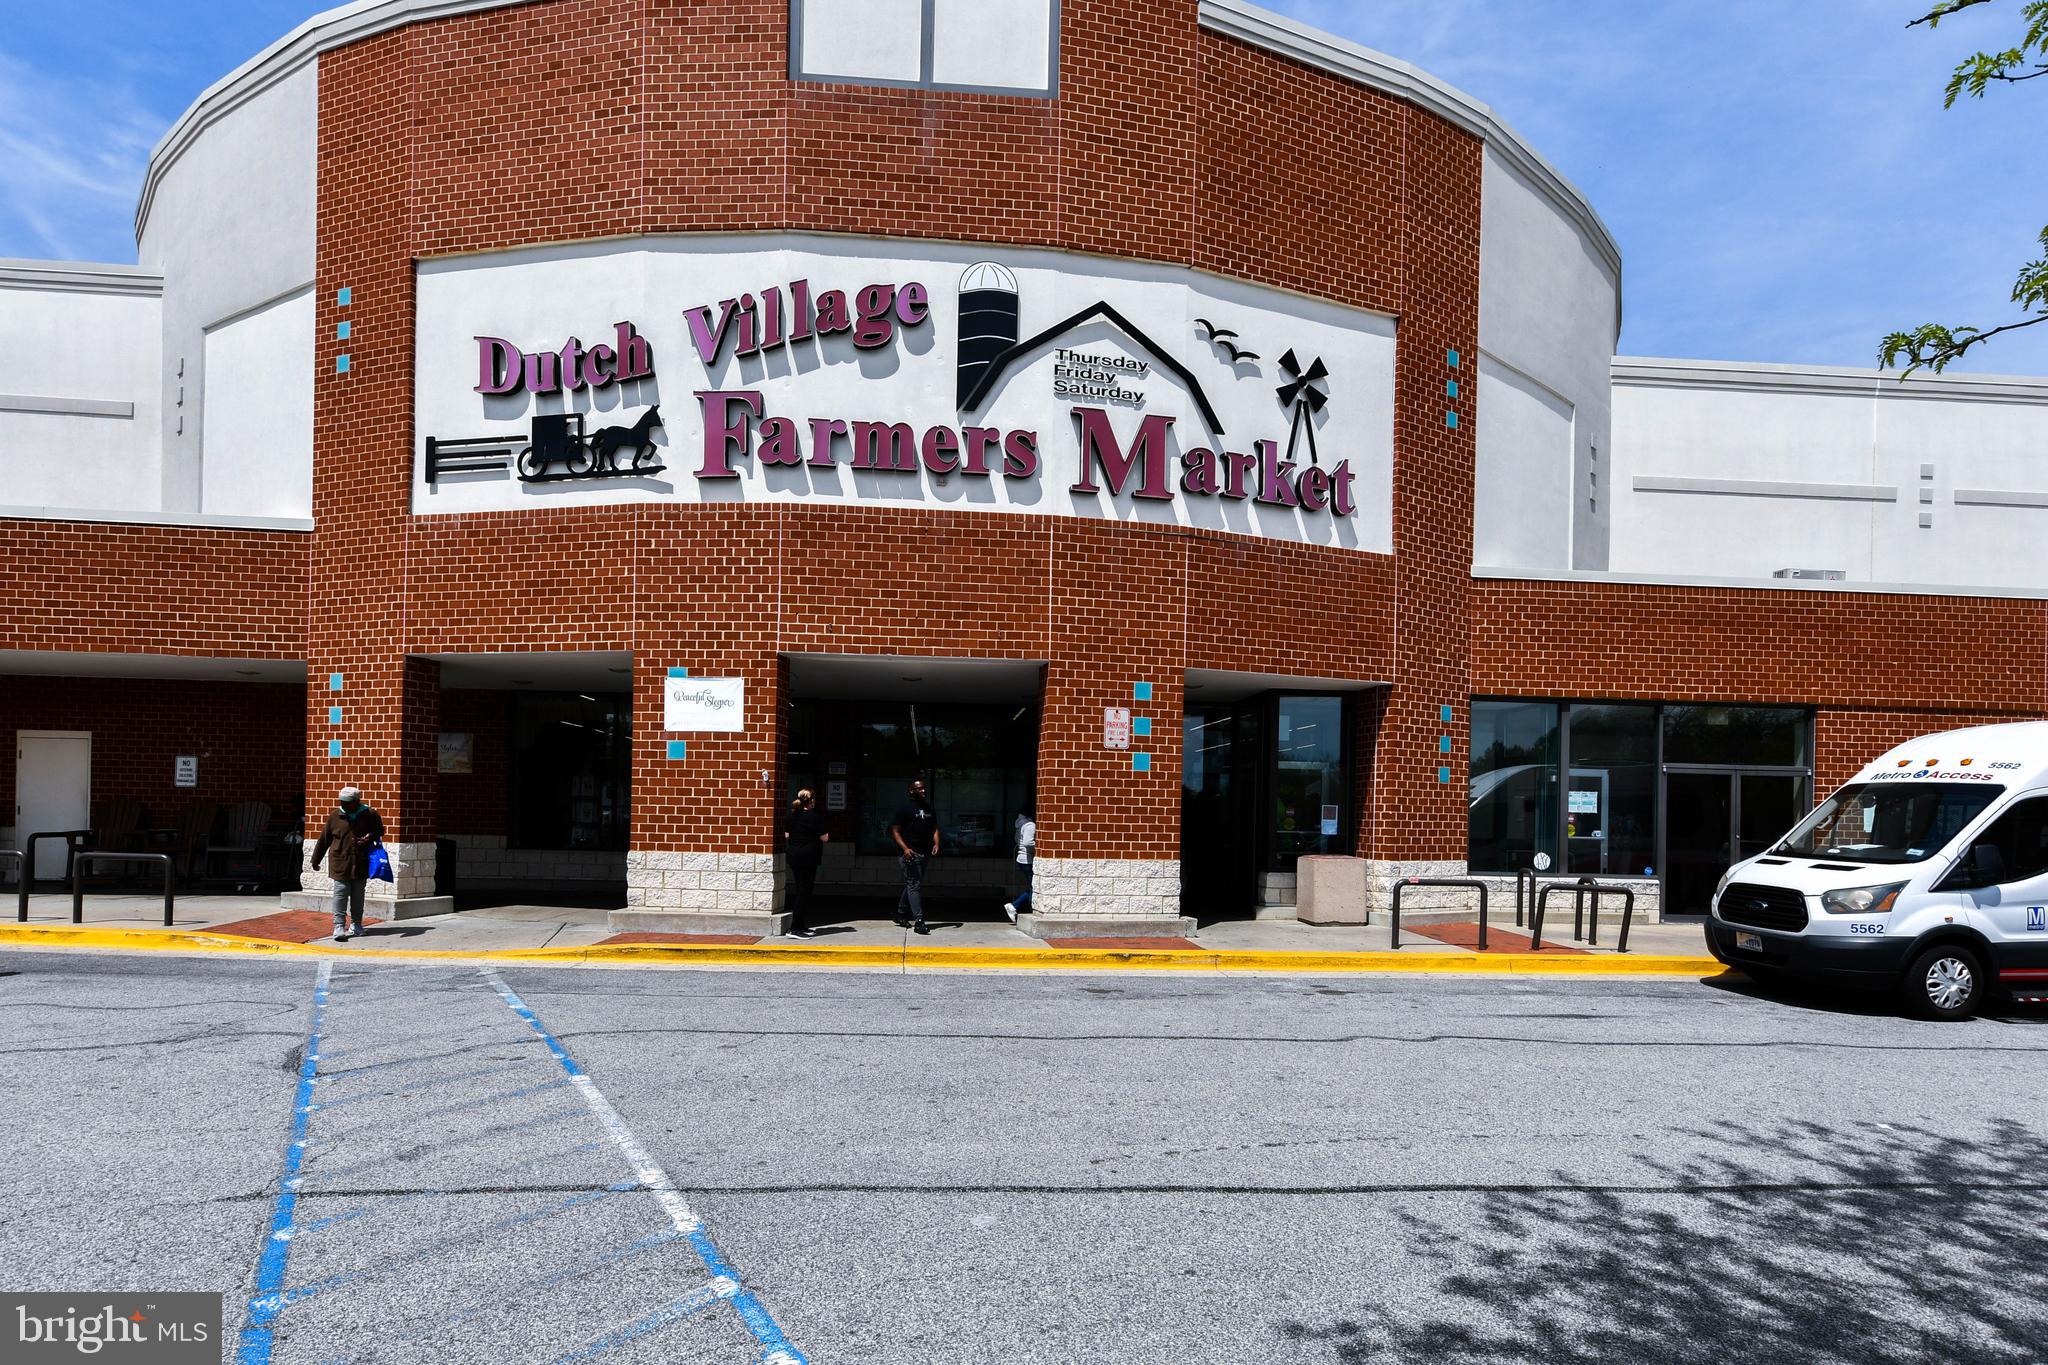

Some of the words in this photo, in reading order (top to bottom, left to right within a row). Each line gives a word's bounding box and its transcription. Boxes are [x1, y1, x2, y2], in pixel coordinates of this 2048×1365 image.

[473, 320, 655, 395] Dutch
[682, 279, 929, 366] Village
[1055, 348, 1149, 372] Thursday
[1054, 364, 1116, 384] Friday
[1053, 380, 1145, 403] Saturday
[693, 390, 1039, 479] Farmers
[1070, 406, 1356, 517] Market
[673, 689, 712, 704] Peaceful
[1113, 712, 1121, 720] NO
[1107, 721, 1128, 729] PARKING
[1988, 762, 2022, 770] 5562
[1870, 772, 1912, 781] Metro
[1926, 771, 1994, 781] Access
[2028, 908, 2044, 925] M
[1850, 924, 1884, 934] 5562
